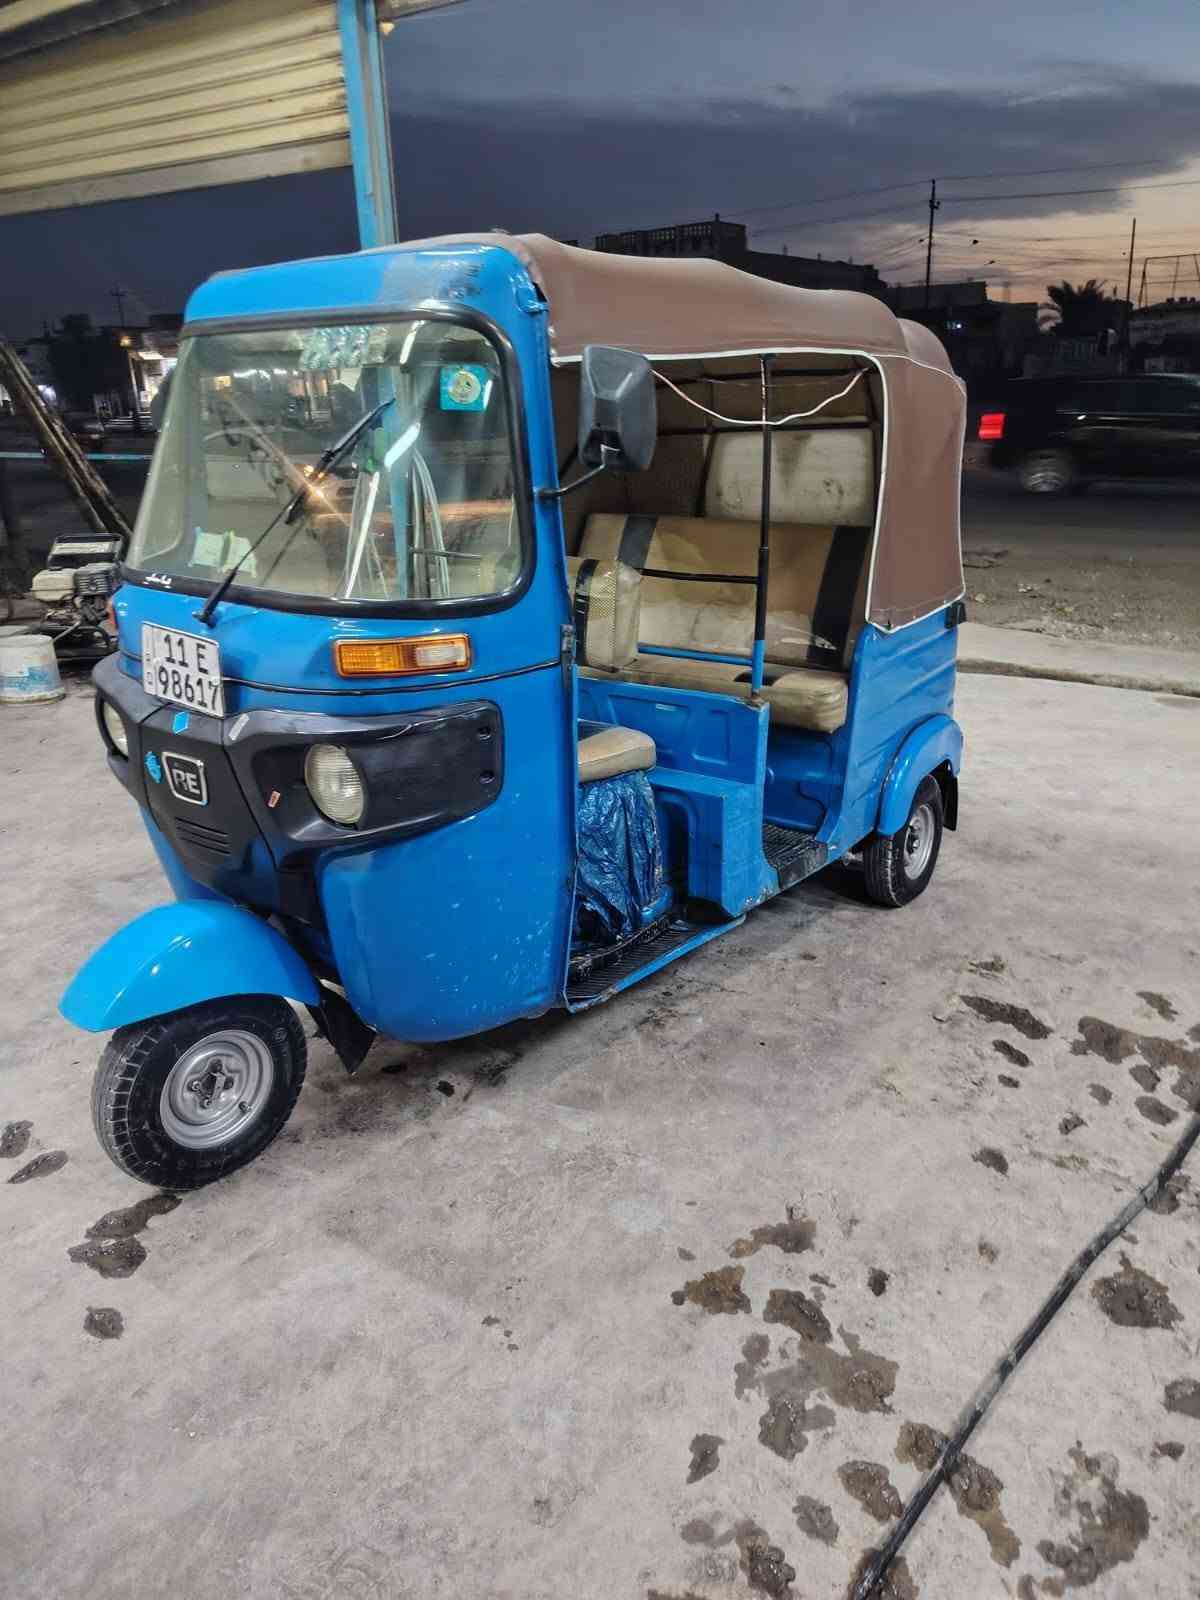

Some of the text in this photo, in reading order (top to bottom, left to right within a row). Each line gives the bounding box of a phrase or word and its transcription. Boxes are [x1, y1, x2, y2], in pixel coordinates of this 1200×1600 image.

[164, 634, 208, 674] 11 E
[159, 666, 218, 711] 98617
[172, 769, 201, 795] RE
